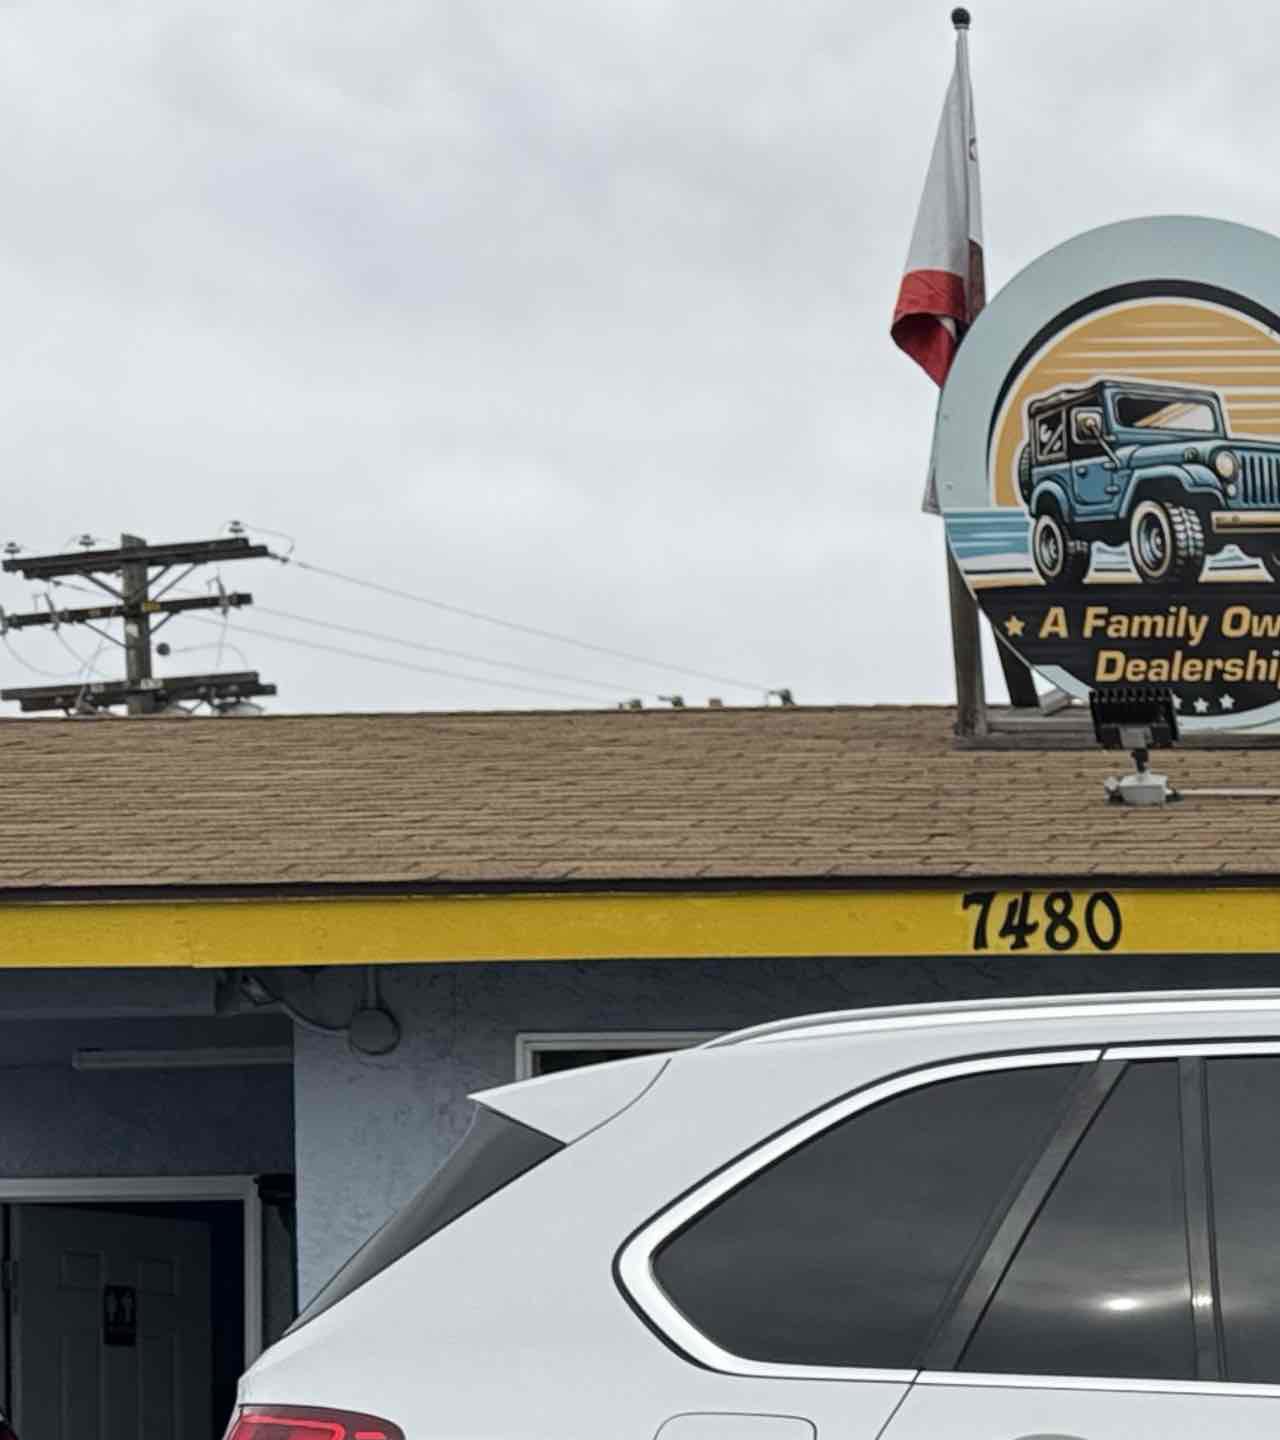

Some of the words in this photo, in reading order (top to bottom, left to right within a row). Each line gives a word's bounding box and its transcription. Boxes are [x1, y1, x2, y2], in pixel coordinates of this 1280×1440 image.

[1038, 606, 1068, 639] A
[1083, 606, 1208, 645] Family
[961, 891, 1122, 950] 7480
